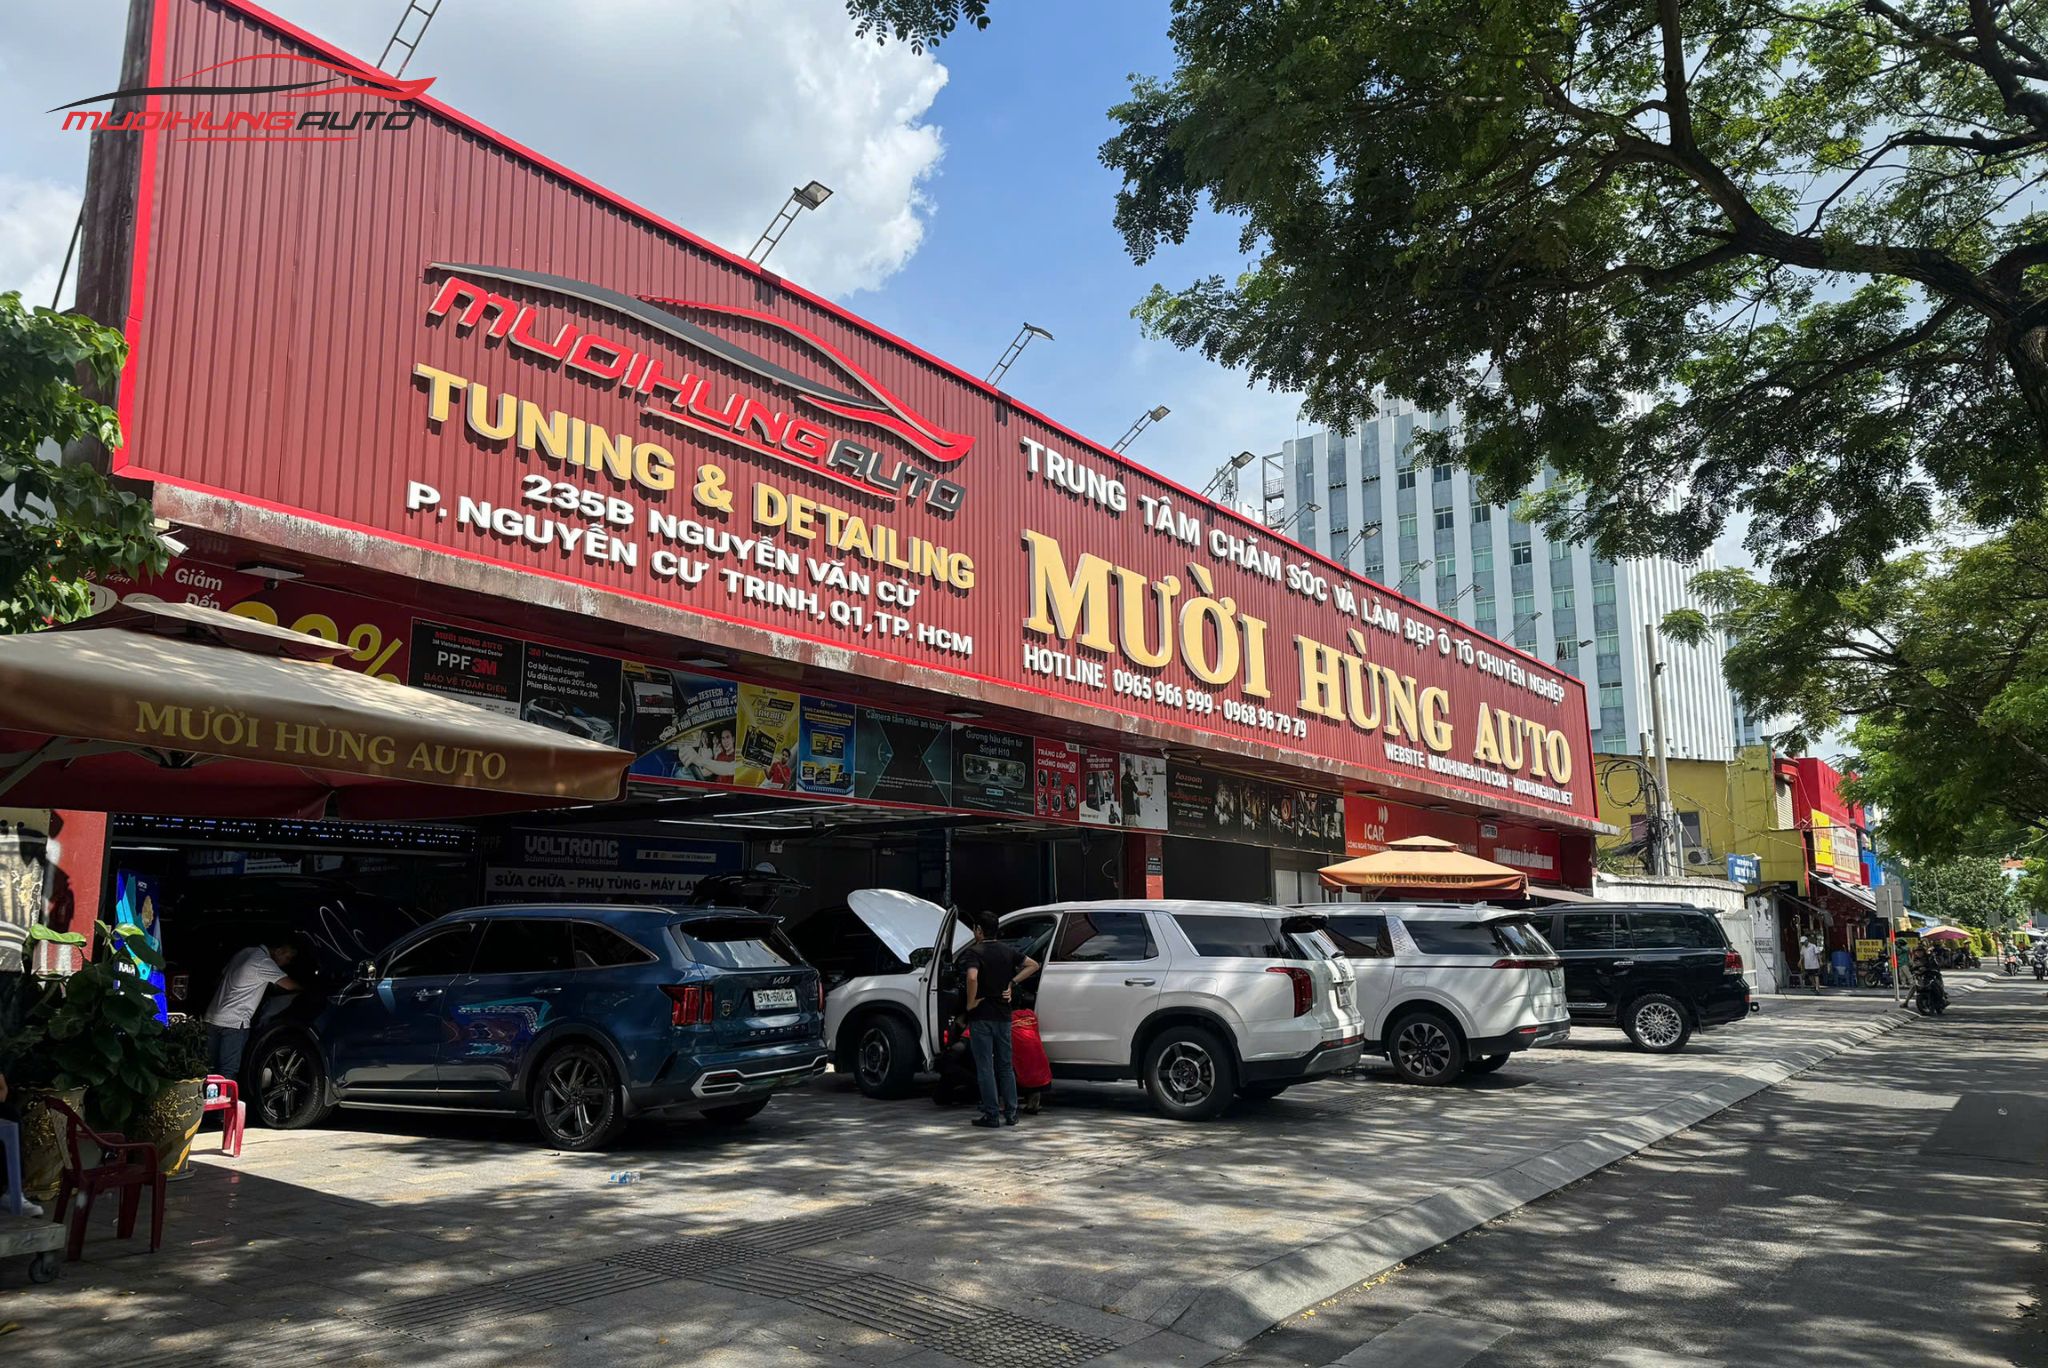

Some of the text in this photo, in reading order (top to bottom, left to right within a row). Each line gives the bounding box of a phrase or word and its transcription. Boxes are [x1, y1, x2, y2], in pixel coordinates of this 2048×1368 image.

[414, 362, 975, 590] TUNING & DETAILING
[407, 479, 448, 518] P.
[457, 495, 638, 567] NGUYỄN
[651, 549, 710, 584] CƯ
[522, 473, 921, 607] 235B NGUYỄN VĂN CỪ
[174, 567, 223, 591] Giảm
[1021, 436, 1566, 706] TRUNG TÂM CHĂM SÓC VÀ LÀM ĐẸP Ô TÔ CHUYÊN NGHIỆP
[437, 650, 497, 677] PPF 3M
[1021, 528, 1572, 785] MƯỜI HÙNG AUTO
[527, 680, 543, 690] Phim
[543, 682, 557, 692] Bảo
[586, 681, 598, 690] cho
[865, 709, 891, 722] Camera
[1112, 668, 1152, 700] 0965
[1154, 680, 1183, 709] 966
[1185, 688, 1213, 715] 999
[1222, 698, 1257, 727] 0968
[1293, 718, 1307, 739] 79
[135, 700, 507, 781] MƯỜI HÙNG AUTO
[1364, 823, 1385, 842] ICAR
[524, 835, 619, 859] VOLTRONIC
[495, 871, 524, 887] SỬA
[527, 873, 566, 888] CHỮA
[577, 876, 604, 890] PHỤ
[608, 876, 641, 890] TÙNG
[651, 876, 675, 890] MÁY
[1439, 875, 1474, 886] AUTO
[773, 975, 791, 985] KIA
